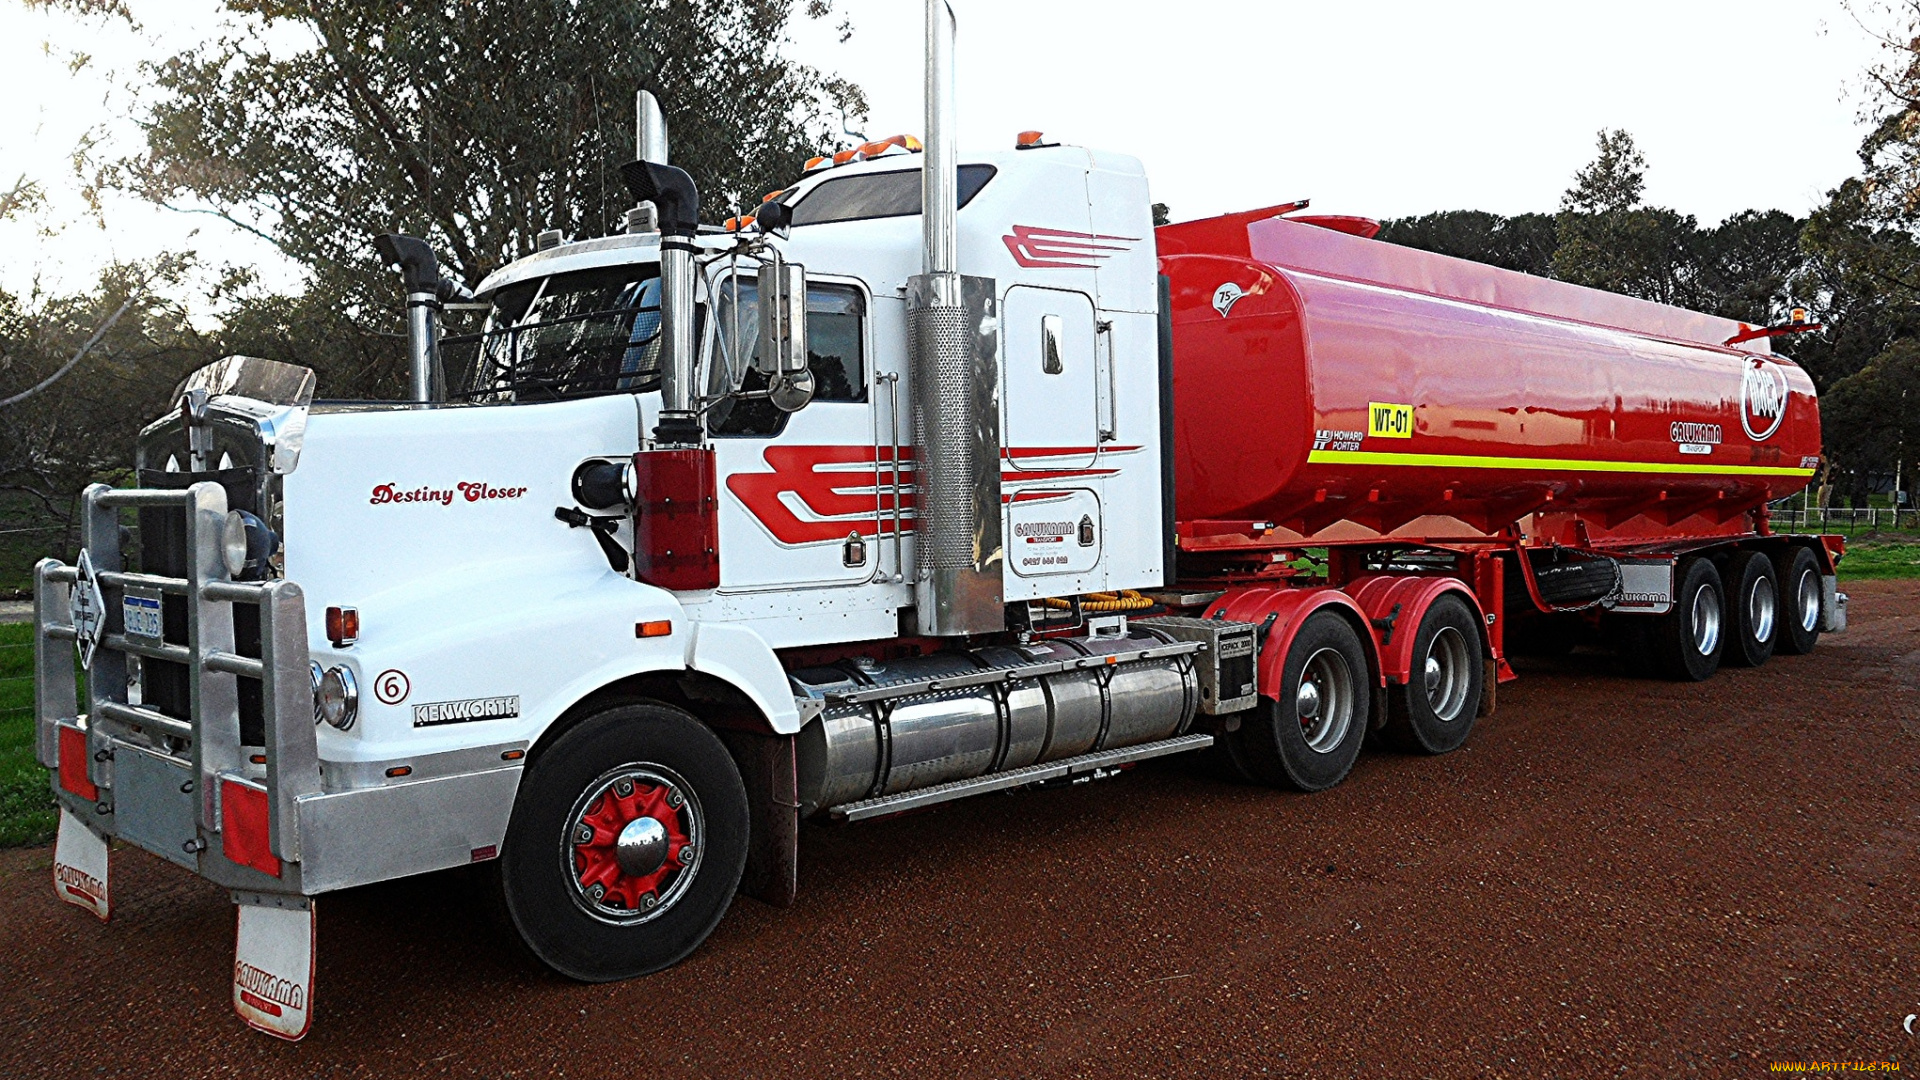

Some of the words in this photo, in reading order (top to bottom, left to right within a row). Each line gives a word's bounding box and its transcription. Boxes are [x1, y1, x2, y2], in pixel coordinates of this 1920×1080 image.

[1219, 291, 1231, 303] 75
[1374, 408, 1408, 433] WT-01
[1334, 430, 1363, 442] HOWARD
[1670, 421, 1722, 444] GALUKAMA
[1332, 441, 1360, 451] PORTER
[369, 482, 454, 506] Destiny
[457, 481, 528, 503] Closer
[1014, 522, 1074, 537] GALUKAMA
[385, 677, 400, 698] 6
[414, 697, 518, 723] KENWORTH
[236, 960, 304, 1011] GALUKAMA
